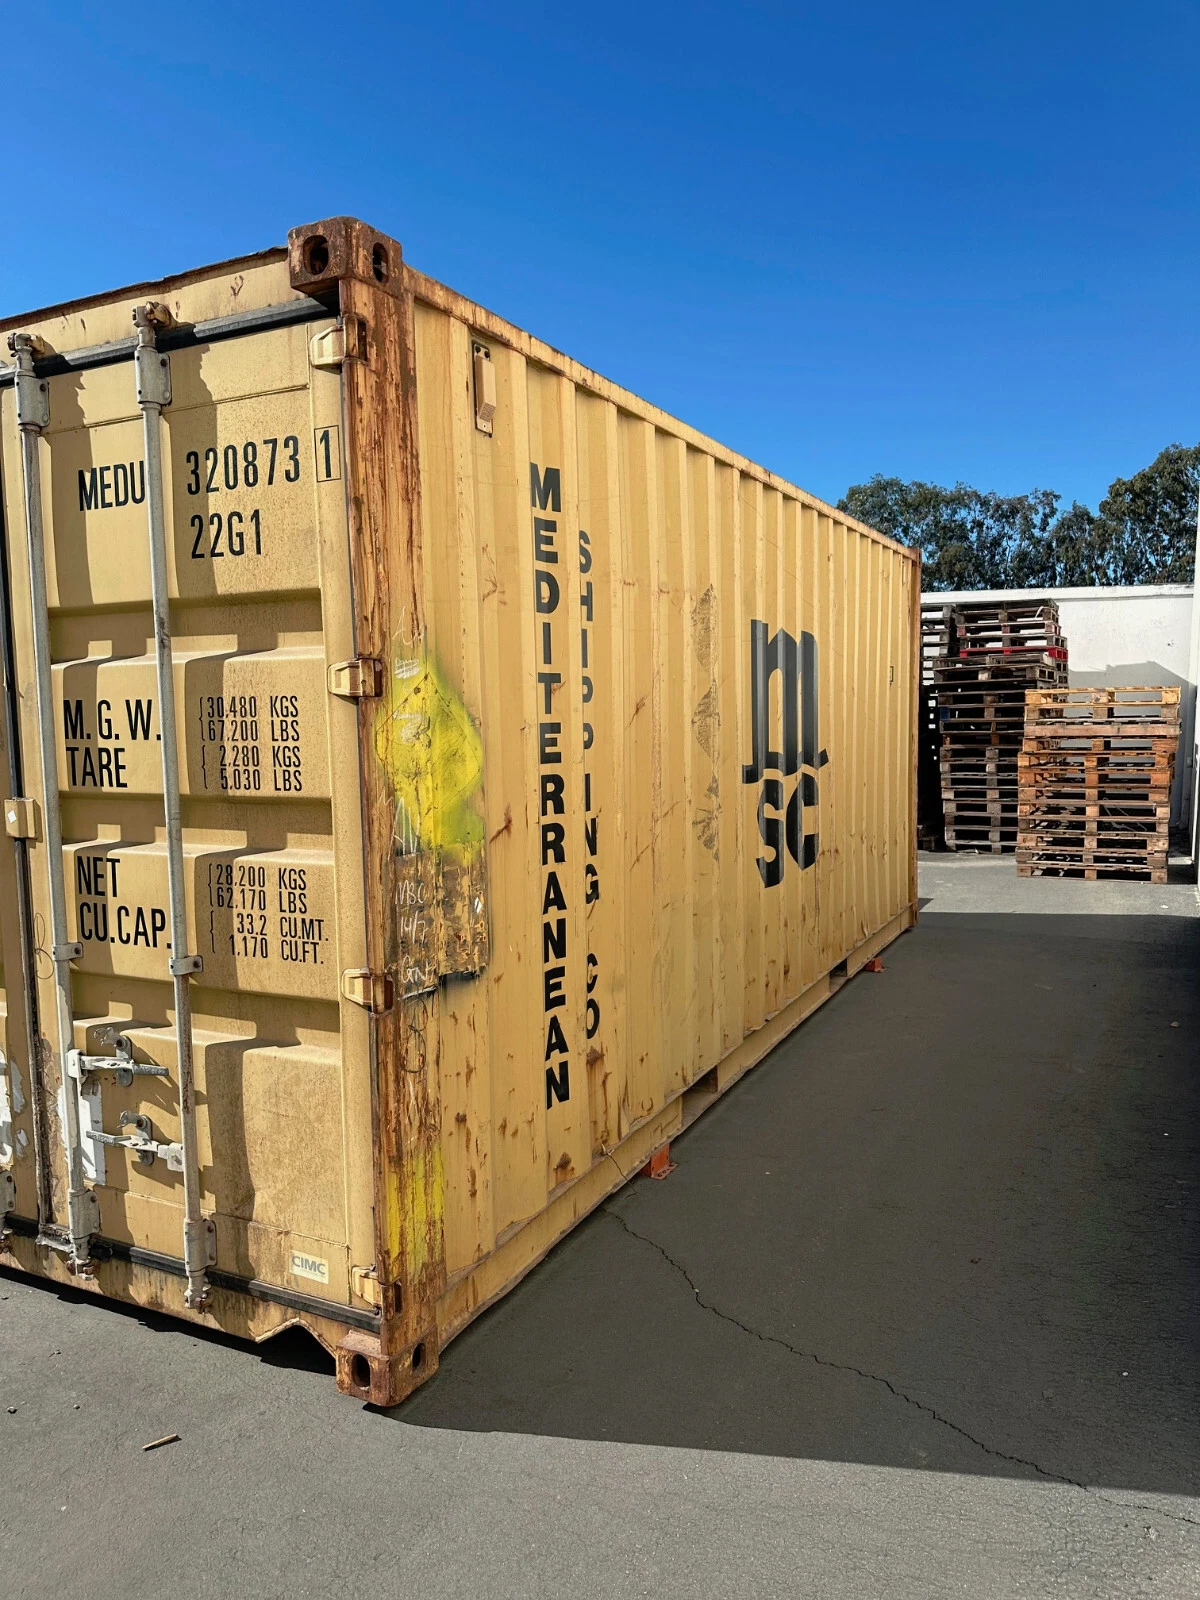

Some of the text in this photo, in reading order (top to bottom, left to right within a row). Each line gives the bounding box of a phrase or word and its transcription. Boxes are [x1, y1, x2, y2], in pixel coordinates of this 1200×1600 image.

[78, 429, 332, 511] MEDU 320873 1
[190, 509, 262, 559] 22G1
[207, 696, 257, 718] 30,480
[270, 695, 299, 718] KGS
[208, 719, 300, 741] 67,200 LBS
[66, 745, 301, 788] TARE 2,280 KGS
[220, 768, 302, 791] 5,030 LBS
[530, 461, 570, 1111] MEDITERRANEAN
[77, 855, 306, 897] NET 28,200 KGS
[217, 886, 307, 914] 62,170 LBS
[79, 901, 329, 950] CU.CAP. 33.2 CU.MT.
[229, 934, 324, 964] 1,170 CU.FT.
[291, 1255, 326, 1275] CIMC
